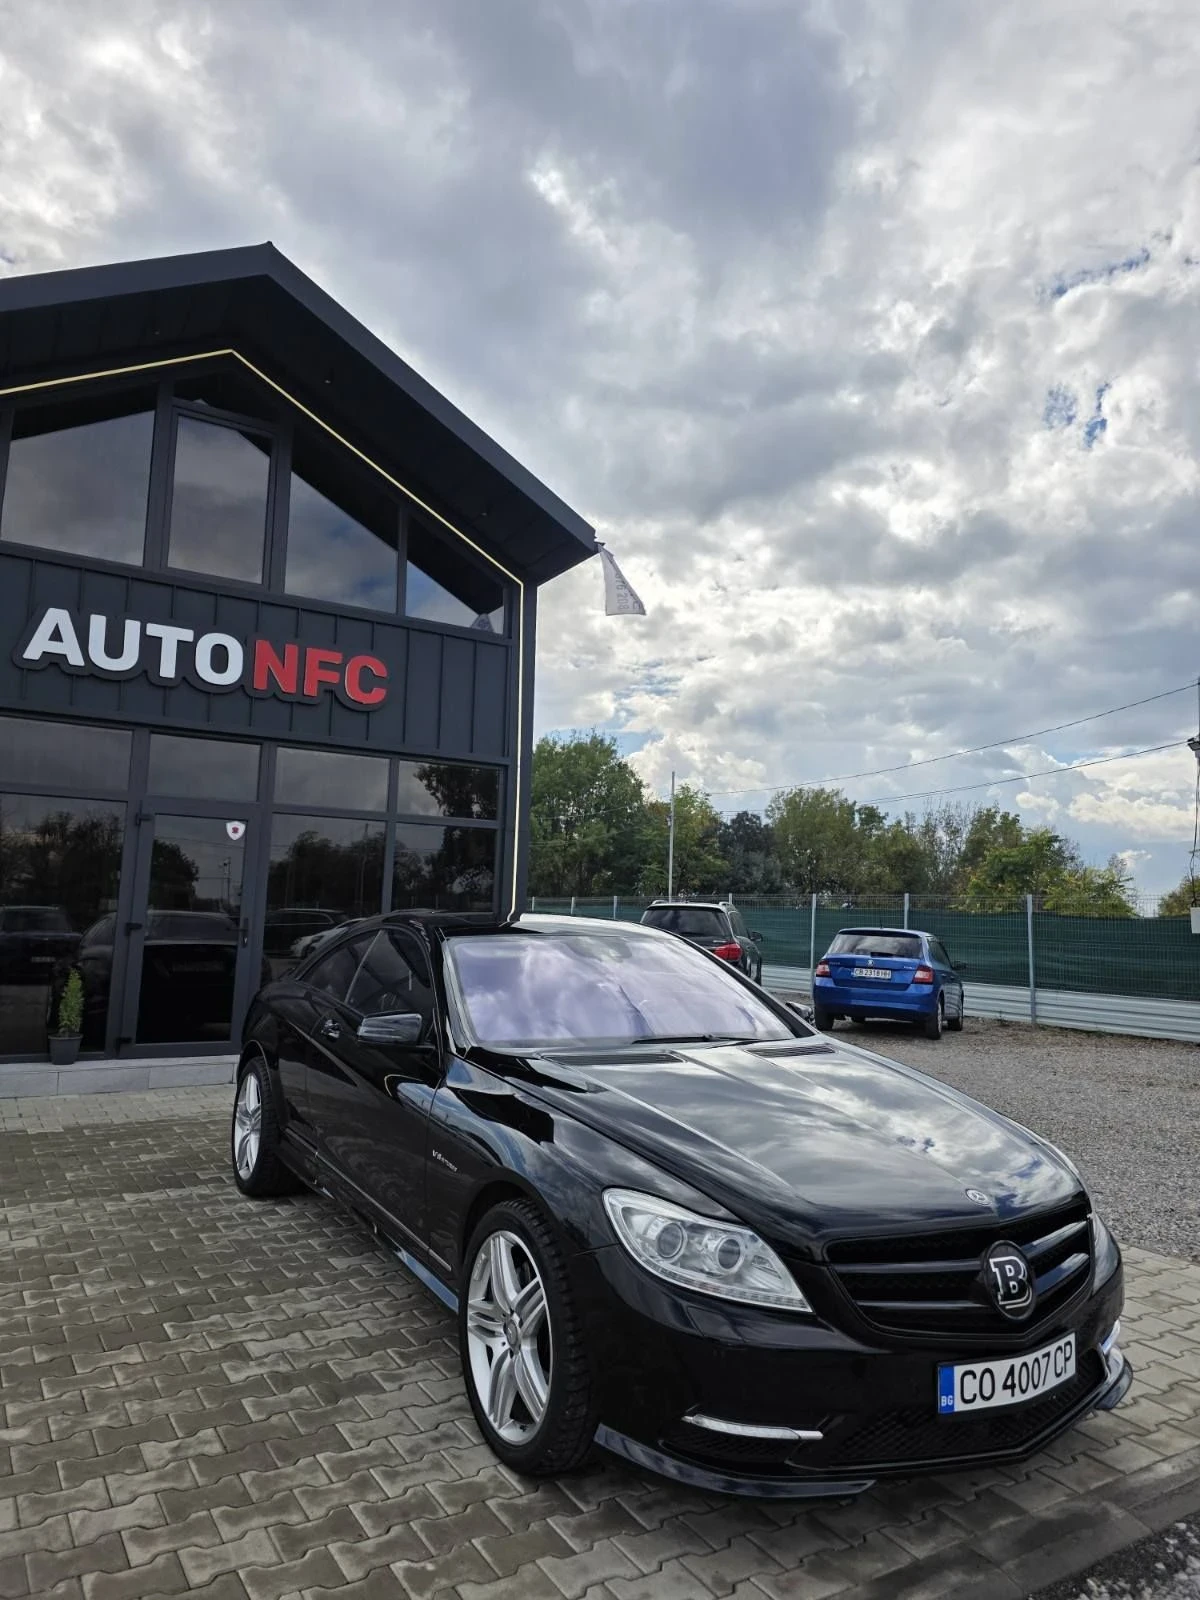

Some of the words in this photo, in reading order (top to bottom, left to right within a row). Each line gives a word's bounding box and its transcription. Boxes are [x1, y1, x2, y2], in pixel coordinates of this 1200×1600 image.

[989, 1256, 1032, 1309] B
[960, 1367, 996, 1404] CO
[1002, 1350, 1052, 1398] 4007
[1054, 1340, 1073, 1378] CP
[940, 1395, 954, 1407] BG
